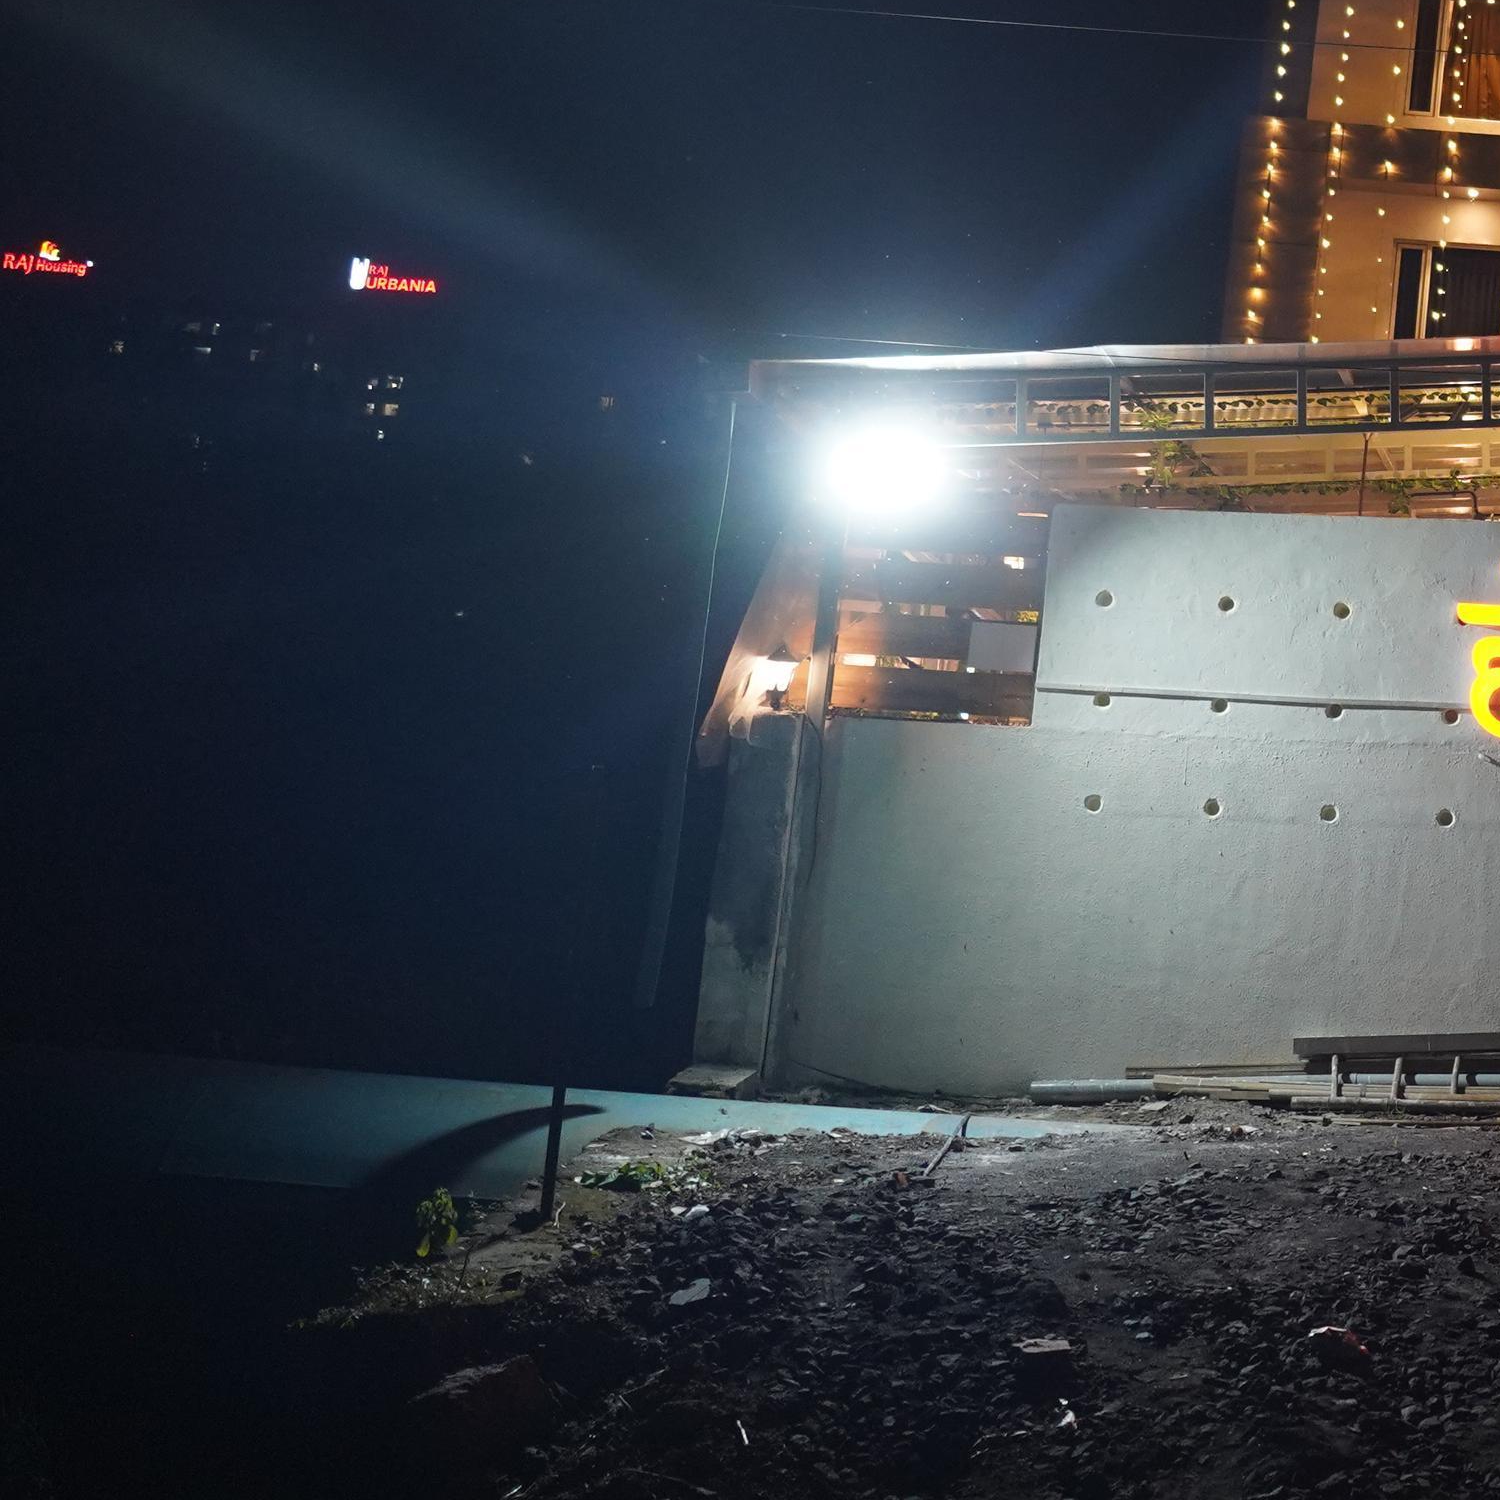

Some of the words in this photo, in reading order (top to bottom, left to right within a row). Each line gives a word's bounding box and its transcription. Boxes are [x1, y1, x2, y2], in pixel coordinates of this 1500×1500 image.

[3, 252, 35, 275] RAJ
[36, 258, 87, 277] Housing
[368, 264, 389, 277] RAJ
[366, 276, 437, 293] URBANIA
